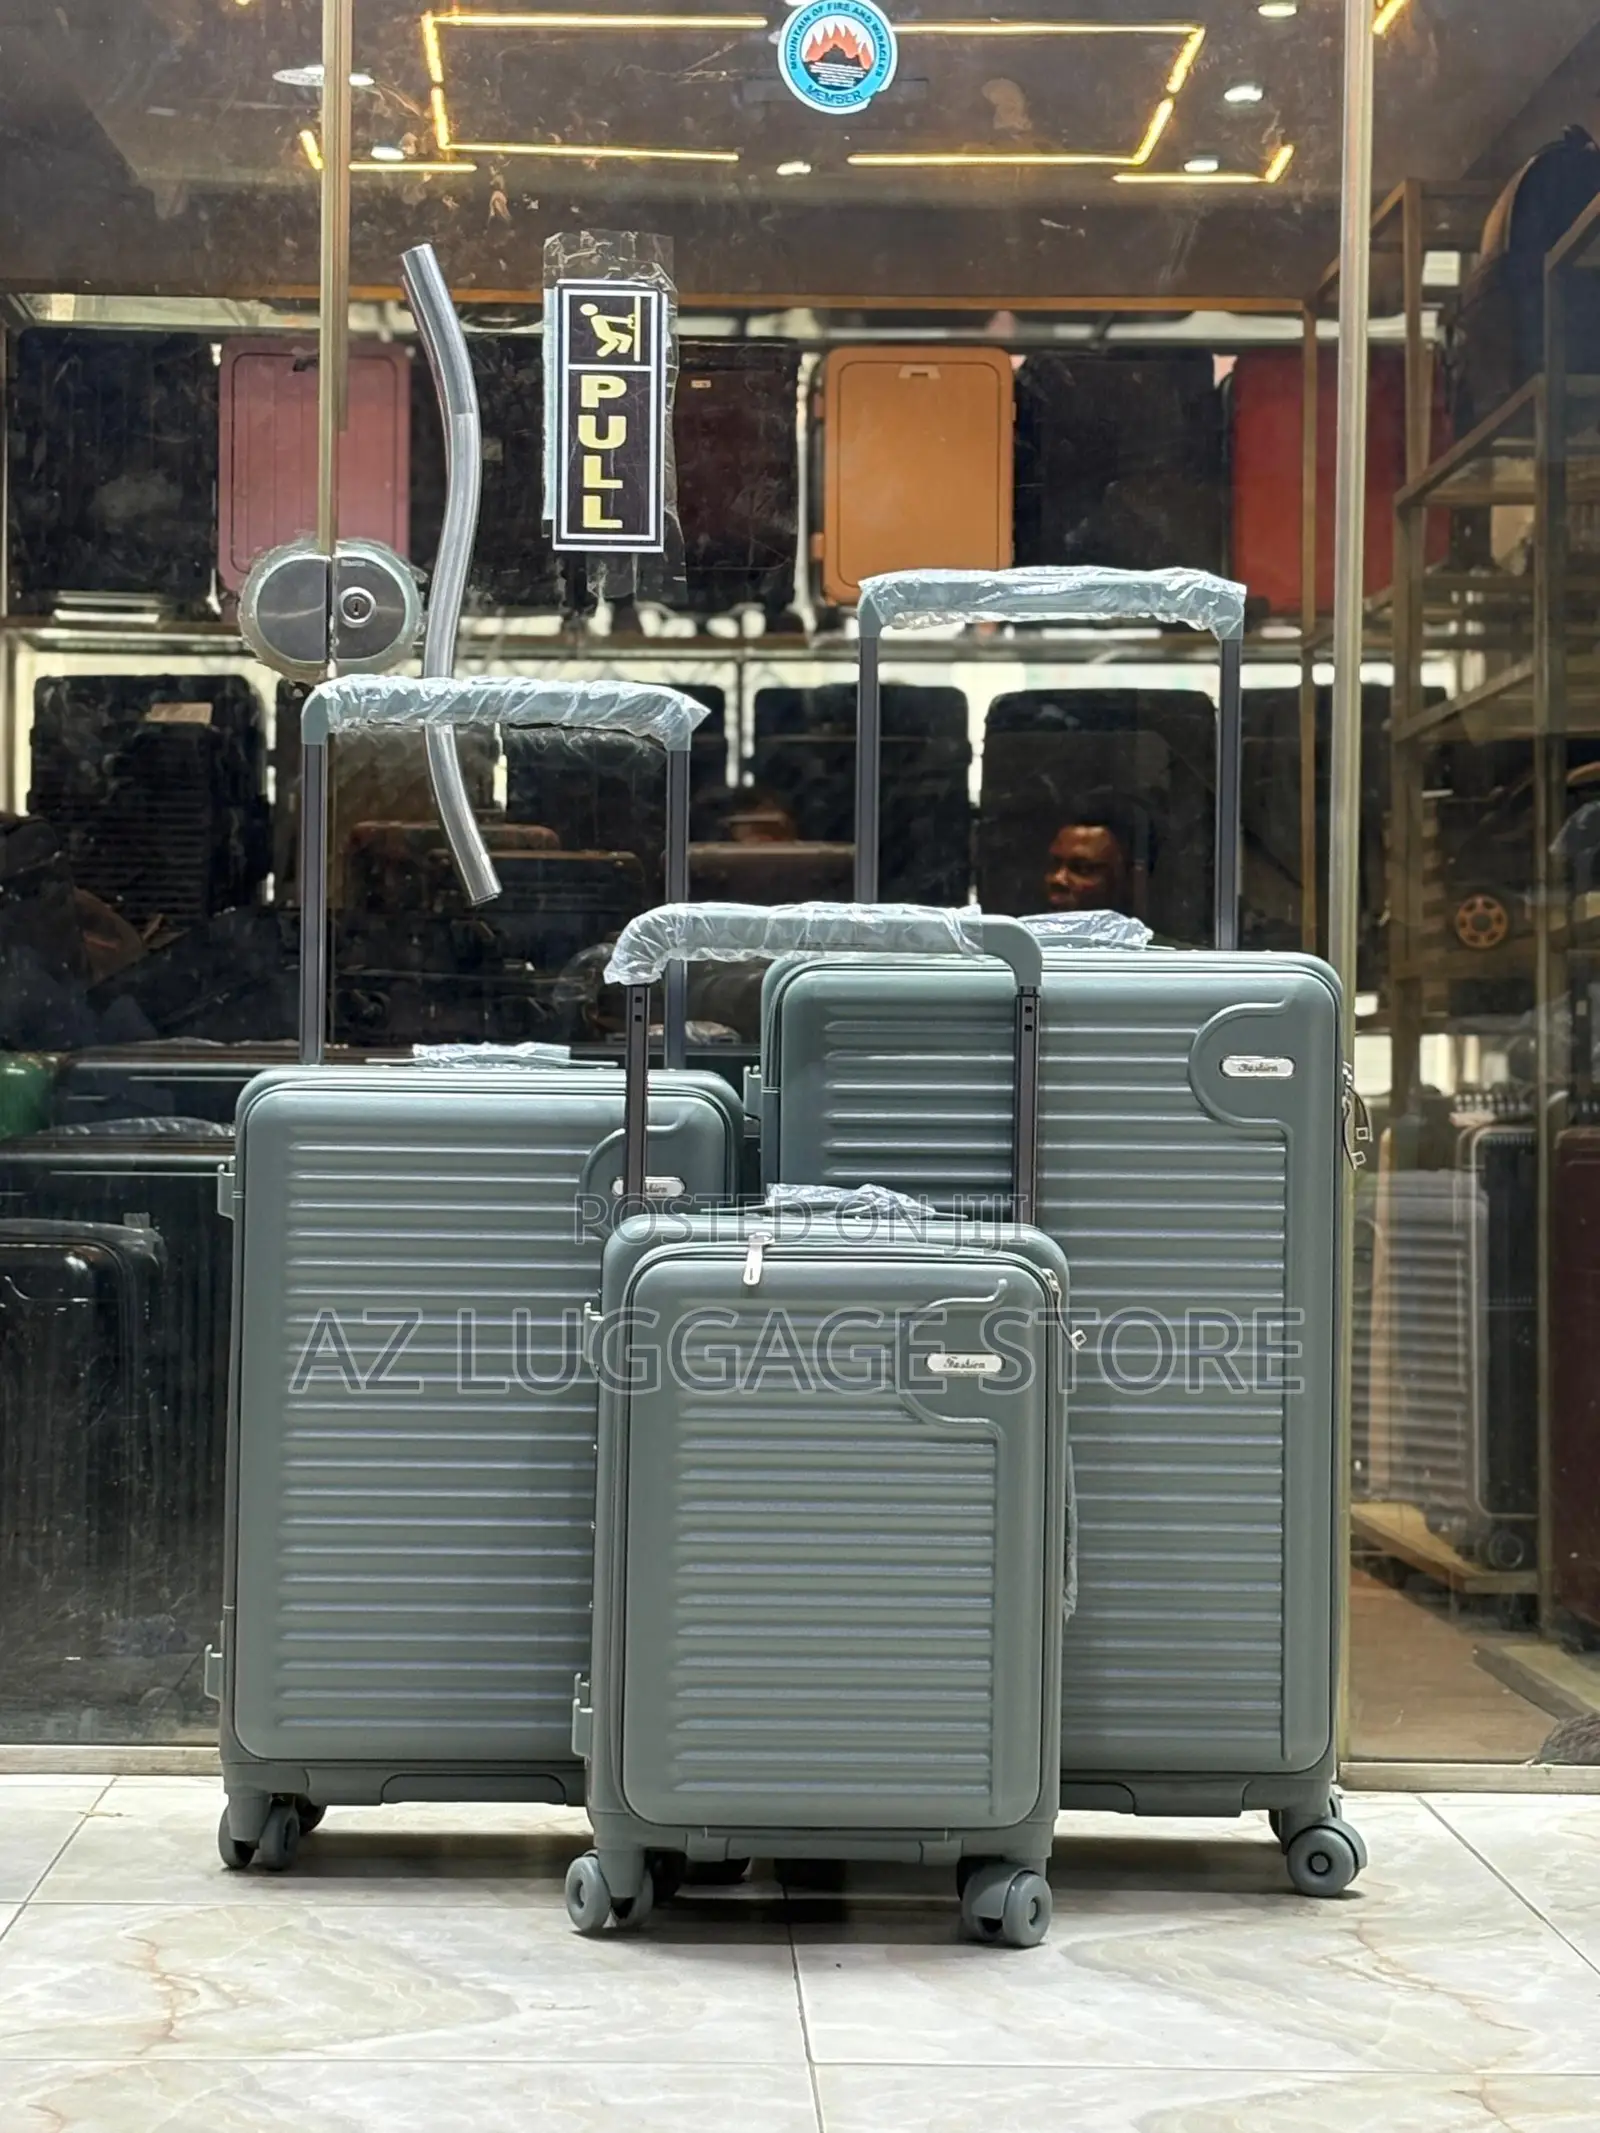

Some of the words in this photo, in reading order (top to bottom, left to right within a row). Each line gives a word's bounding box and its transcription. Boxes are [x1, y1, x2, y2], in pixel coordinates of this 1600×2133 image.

[790, 15, 811, 70] MOUNTAIN
[812, 5, 823, 16] OF
[827, 2, 850, 12] FIRE
[852, 7, 872, 23] AND
[805, 84, 863, 104] MEMBER
[577, 373, 628, 529] PULL
